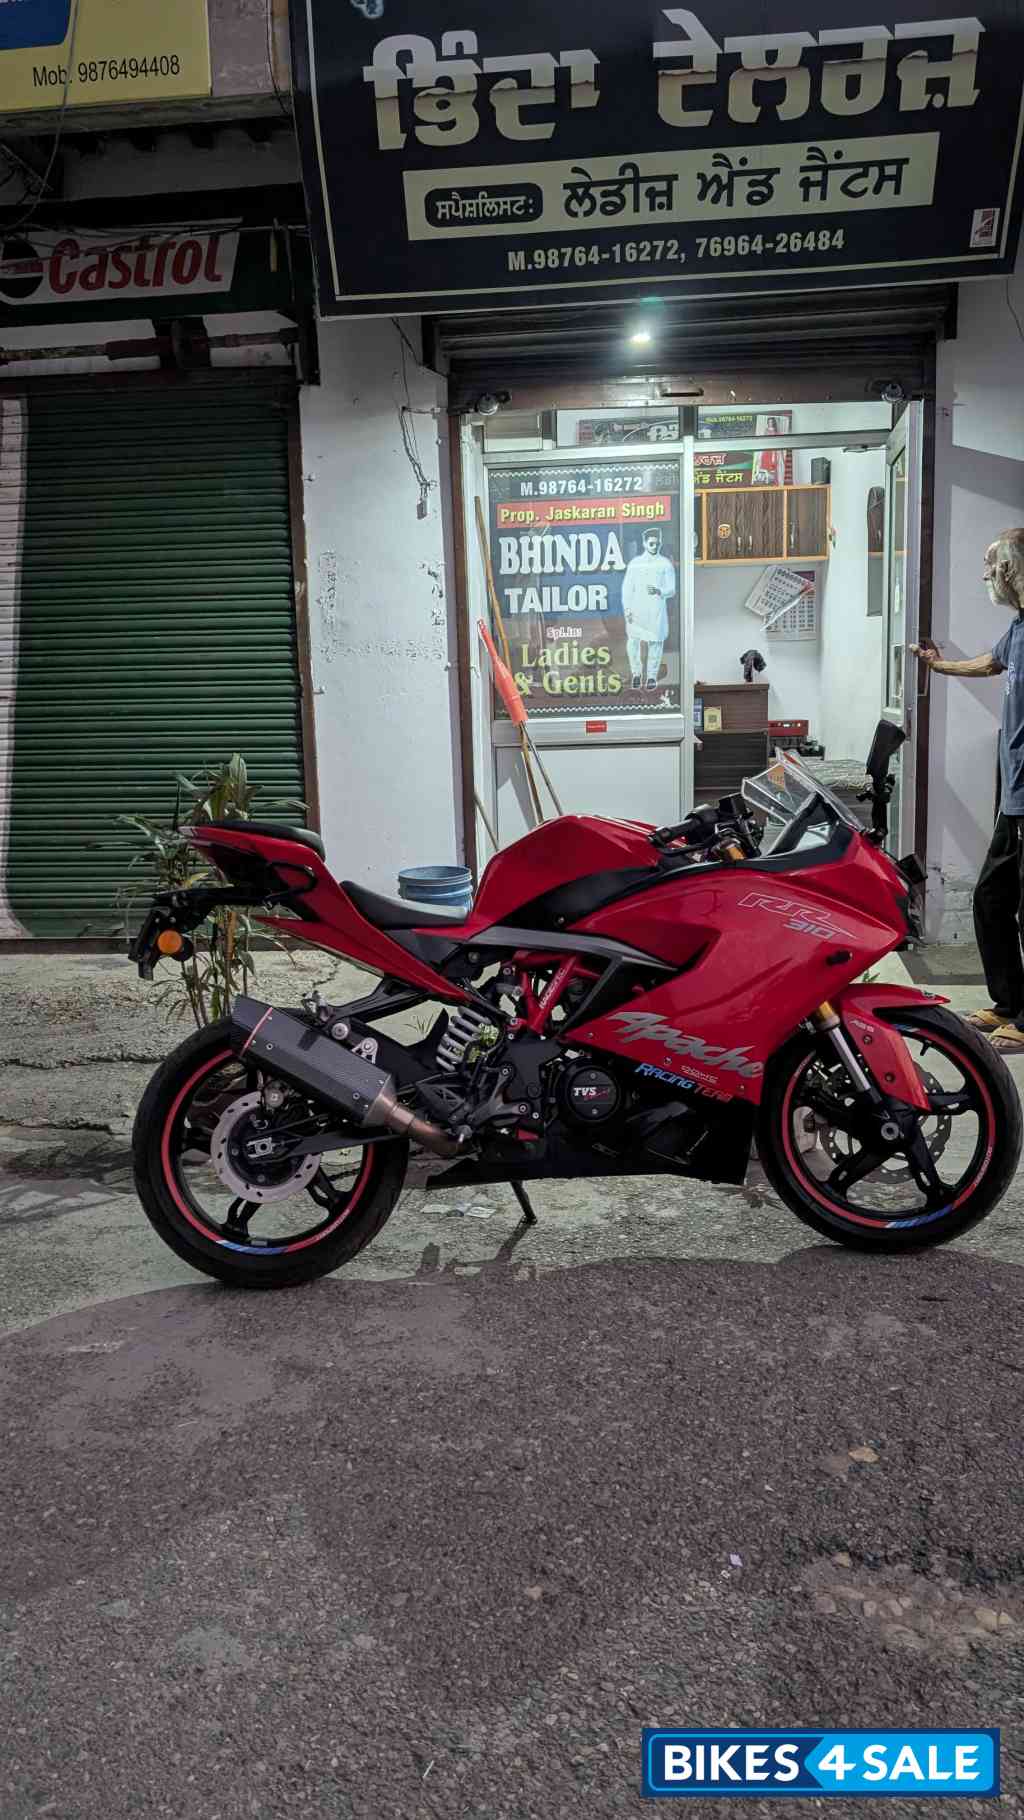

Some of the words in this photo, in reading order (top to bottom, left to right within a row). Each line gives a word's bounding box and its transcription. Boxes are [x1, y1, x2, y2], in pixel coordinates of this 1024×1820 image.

[32, 65, 72, 87] Mob.
[78, 54, 180, 82] 9876494408
[562, 162, 679, 218] ਲੇਡੀਜ਼
[697, 152, 780, 207] ਐਂਡ
[798, 146, 910, 202] ਜੈਂਟਸ
[50, 233, 223, 294] Castrol
[508, 239, 686, 271] M.98764-16272,
[695, 229, 845, 258] 76964-26484
[520, 477, 643, 497] M.98764-16272
[500, 509, 540, 525] Prop.
[545, 504, 616, 522] Jaskaran
[621, 501, 665, 521] Singh
[498, 531, 627, 575] BHINDA
[504, 584, 609, 614] TAILOR
[520, 640, 612, 667] Ladies
[514, 671, 534, 697] &
[543, 668, 622, 695] Gents
[783, 921, 836, 939] 310
[607, 1011, 765, 1078] Apache
[634, 1062, 695, 1089] RACING
[573, 1087, 597, 1096] TVS
